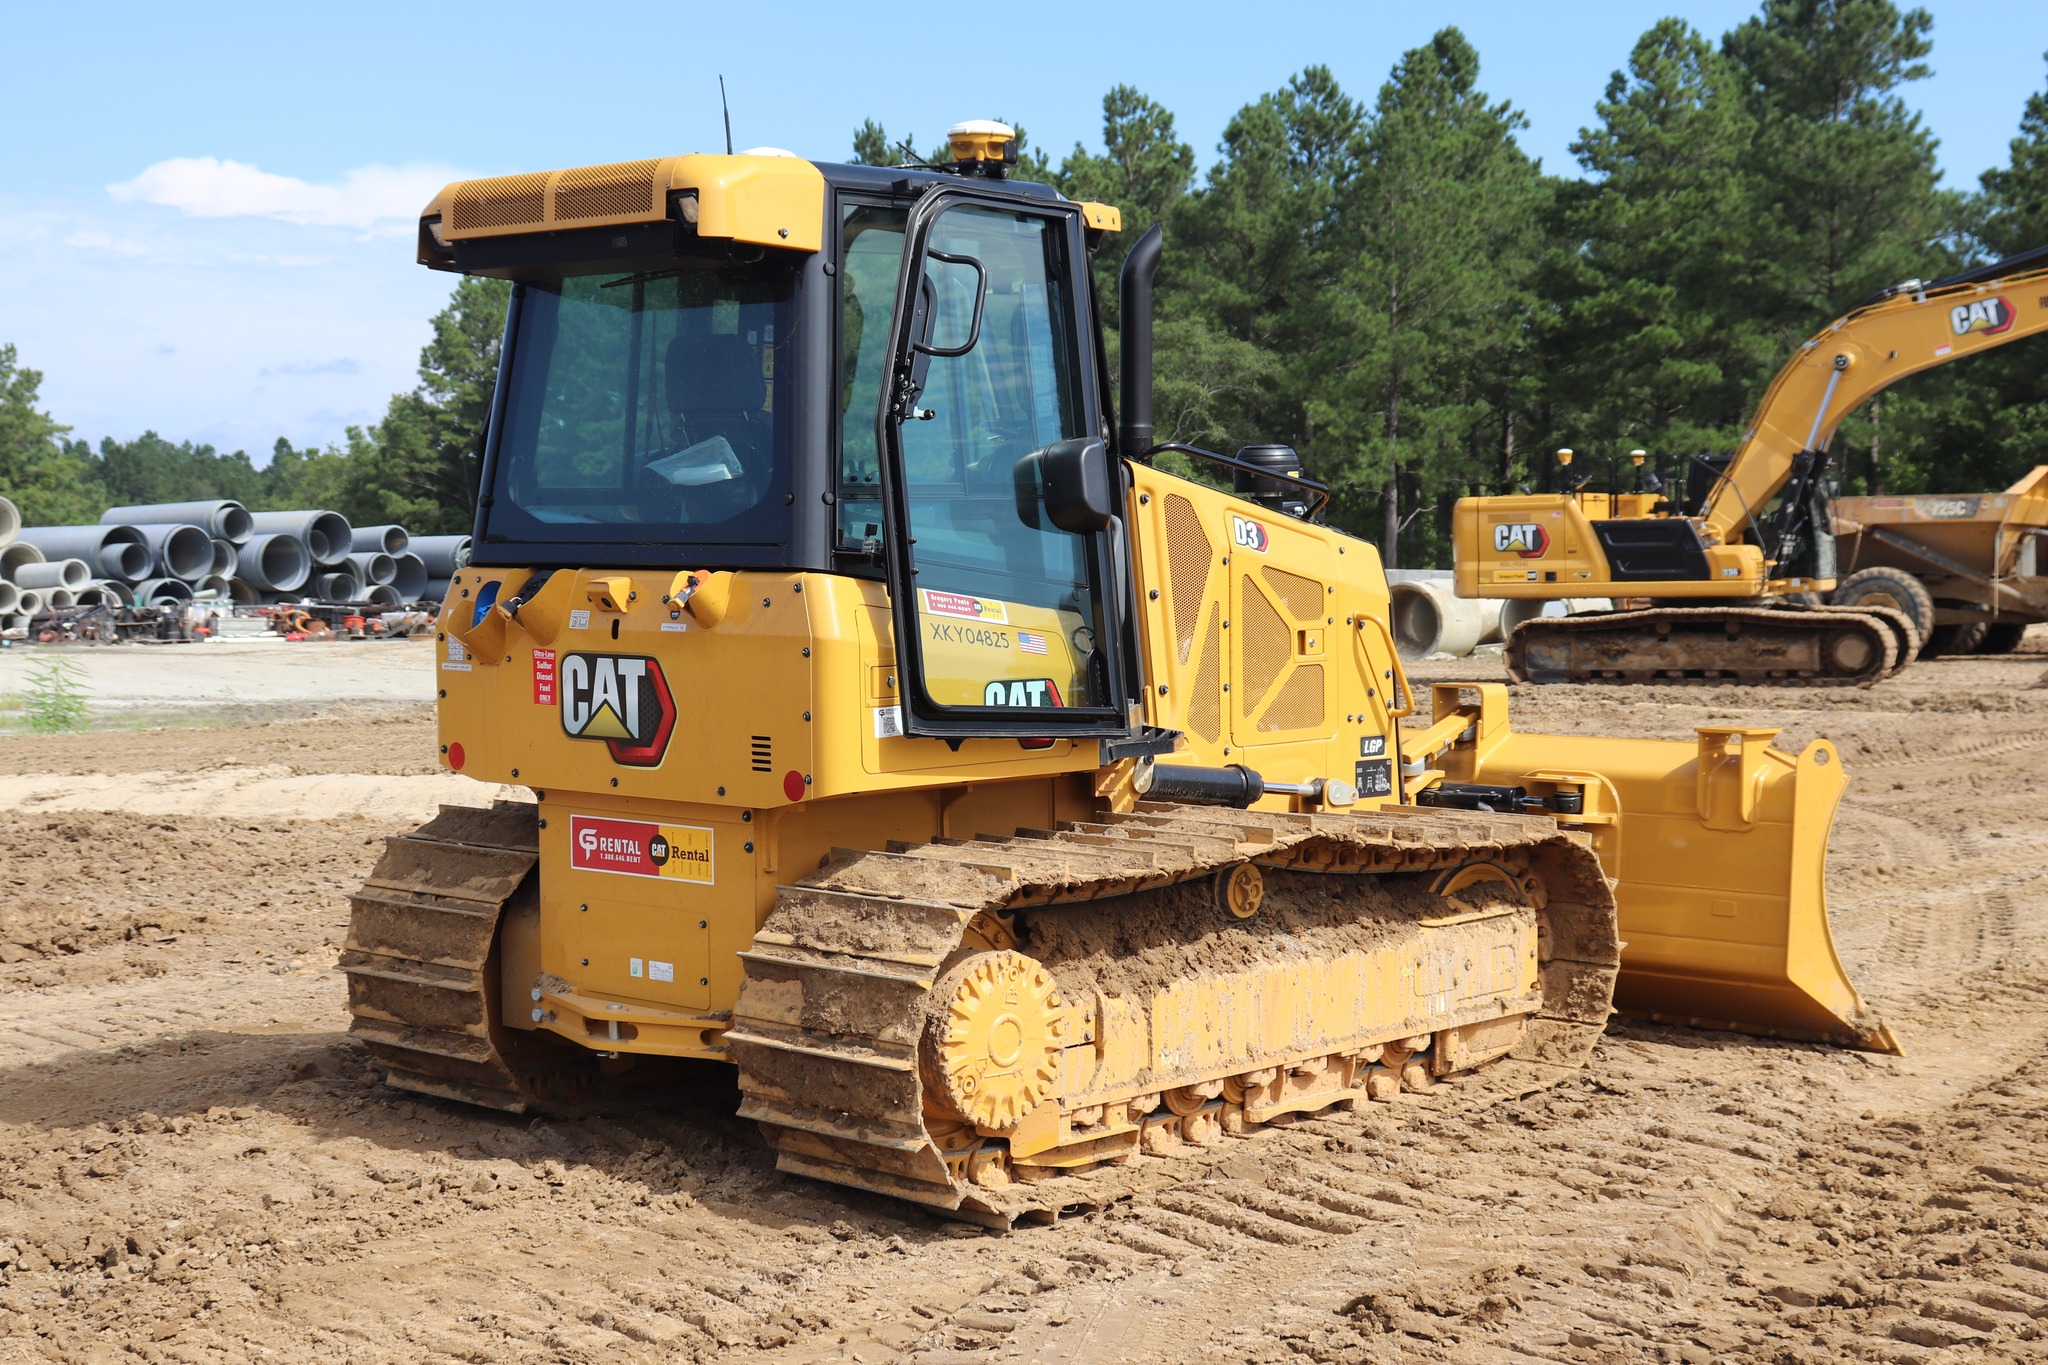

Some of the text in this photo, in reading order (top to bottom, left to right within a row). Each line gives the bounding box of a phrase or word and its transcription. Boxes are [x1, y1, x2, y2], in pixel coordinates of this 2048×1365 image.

[1952, 297, 1999, 334] CAT
[1233, 516, 1259, 549] D3
[1495, 524, 1537, 551] CAT
[930, 593, 952, 604] Gregory
[930, 622, 1010, 649] XKY04825
[533, 650, 555, 658] Ultra-Low
[536, 661, 553, 669] Sulfur
[536, 672, 553, 680] Diesel
[539, 683, 551, 692] Fuel
[562, 655, 646, 739] CAT
[1363, 739, 1383, 753] LGP
[600, 837, 641, 855] RENTAL
[652, 844, 666, 858] CAT
[671, 846, 710, 862] Rental
